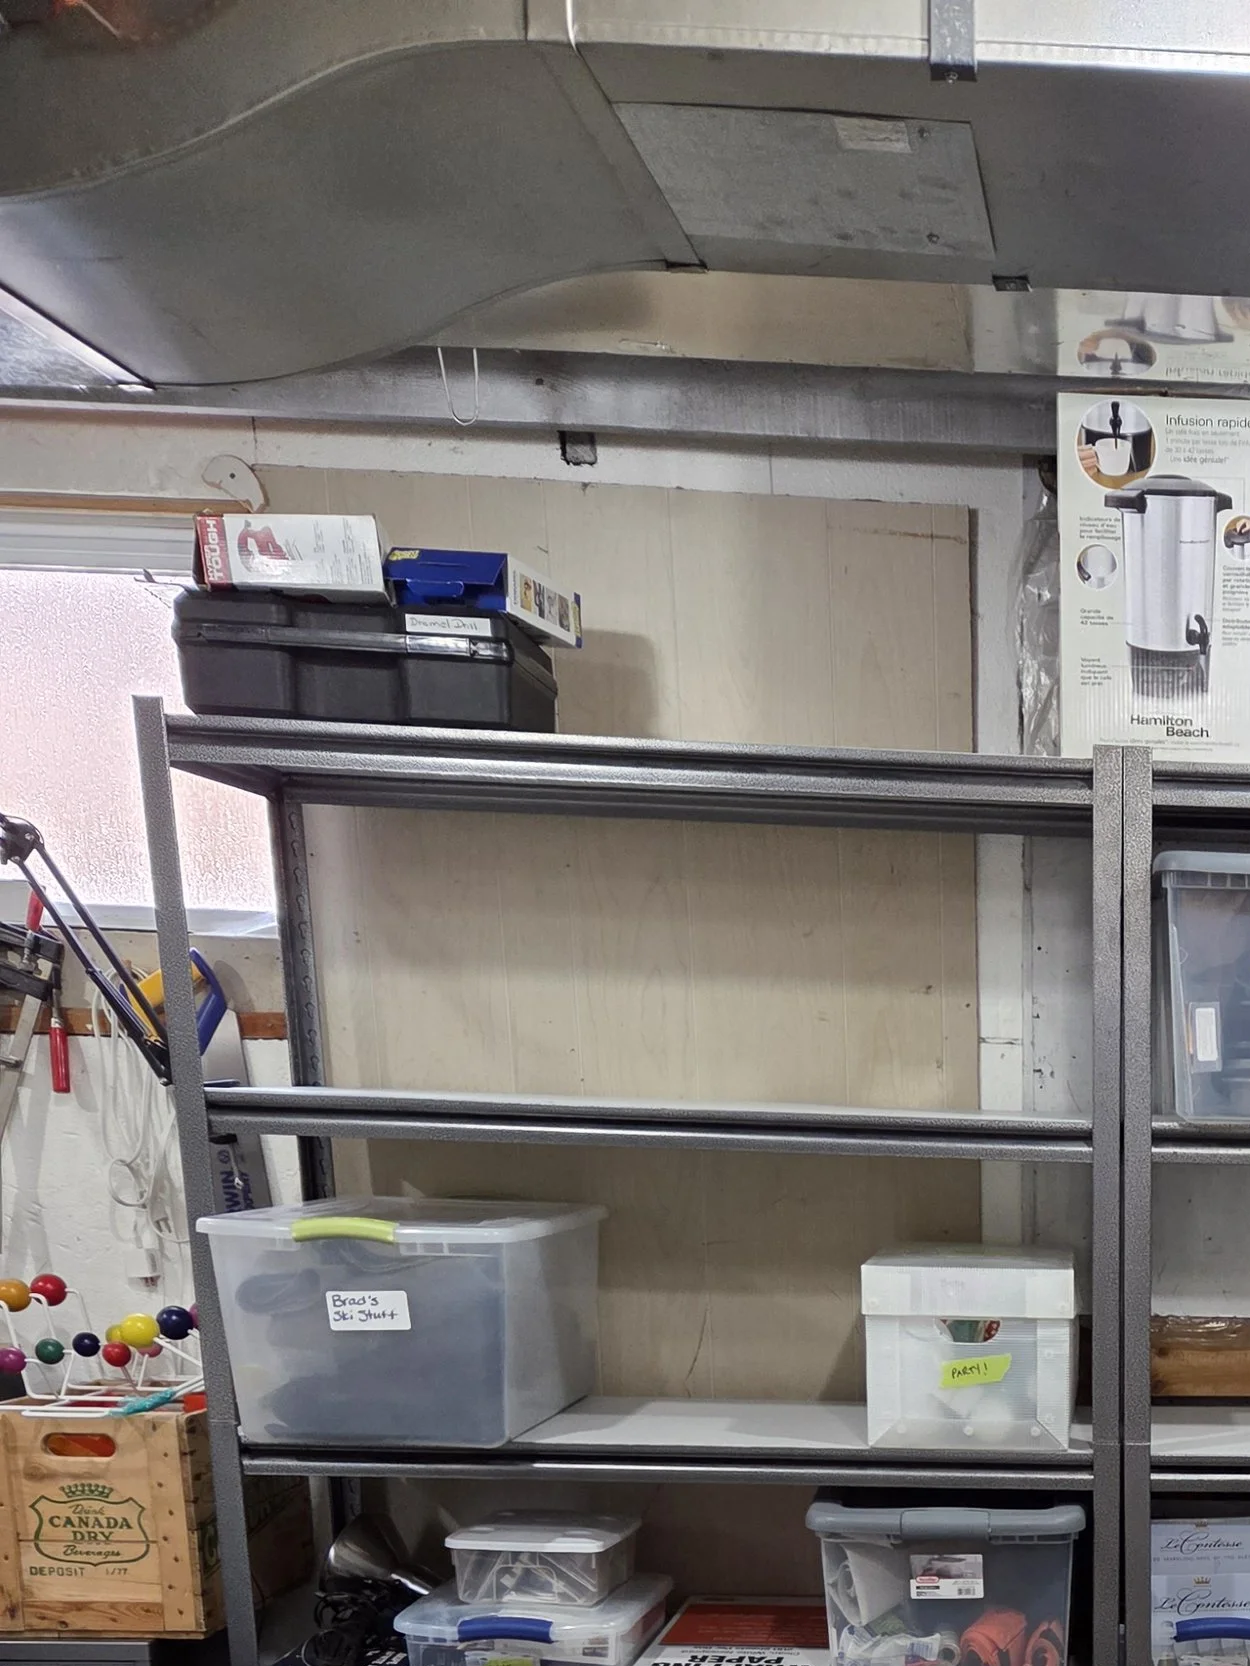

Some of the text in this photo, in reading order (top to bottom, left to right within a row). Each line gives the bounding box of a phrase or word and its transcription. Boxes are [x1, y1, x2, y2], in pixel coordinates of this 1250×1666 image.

[1165, 414, 1214, 428] Infusion
[205, 519, 225, 581] TOUGH
[410, 617, 480, 631] Dremel Drill
[1130, 714, 1193, 727] Hamilton
[1166, 726, 1209, 738] Beach
[331, 1294, 380, 1308] Brad's
[332, 1308, 400, 1323] Ski Stuff
[951, 1363, 989, 1381] PARTY!
[48, 1515, 134, 1531] CANADA
[72, 1530, 115, 1543] DRY
[62, 1544, 122, 1560] Beverages
[29, 1566, 86, 1578] DEPOSIT
[687, 1655, 785, 1664] PAPER
